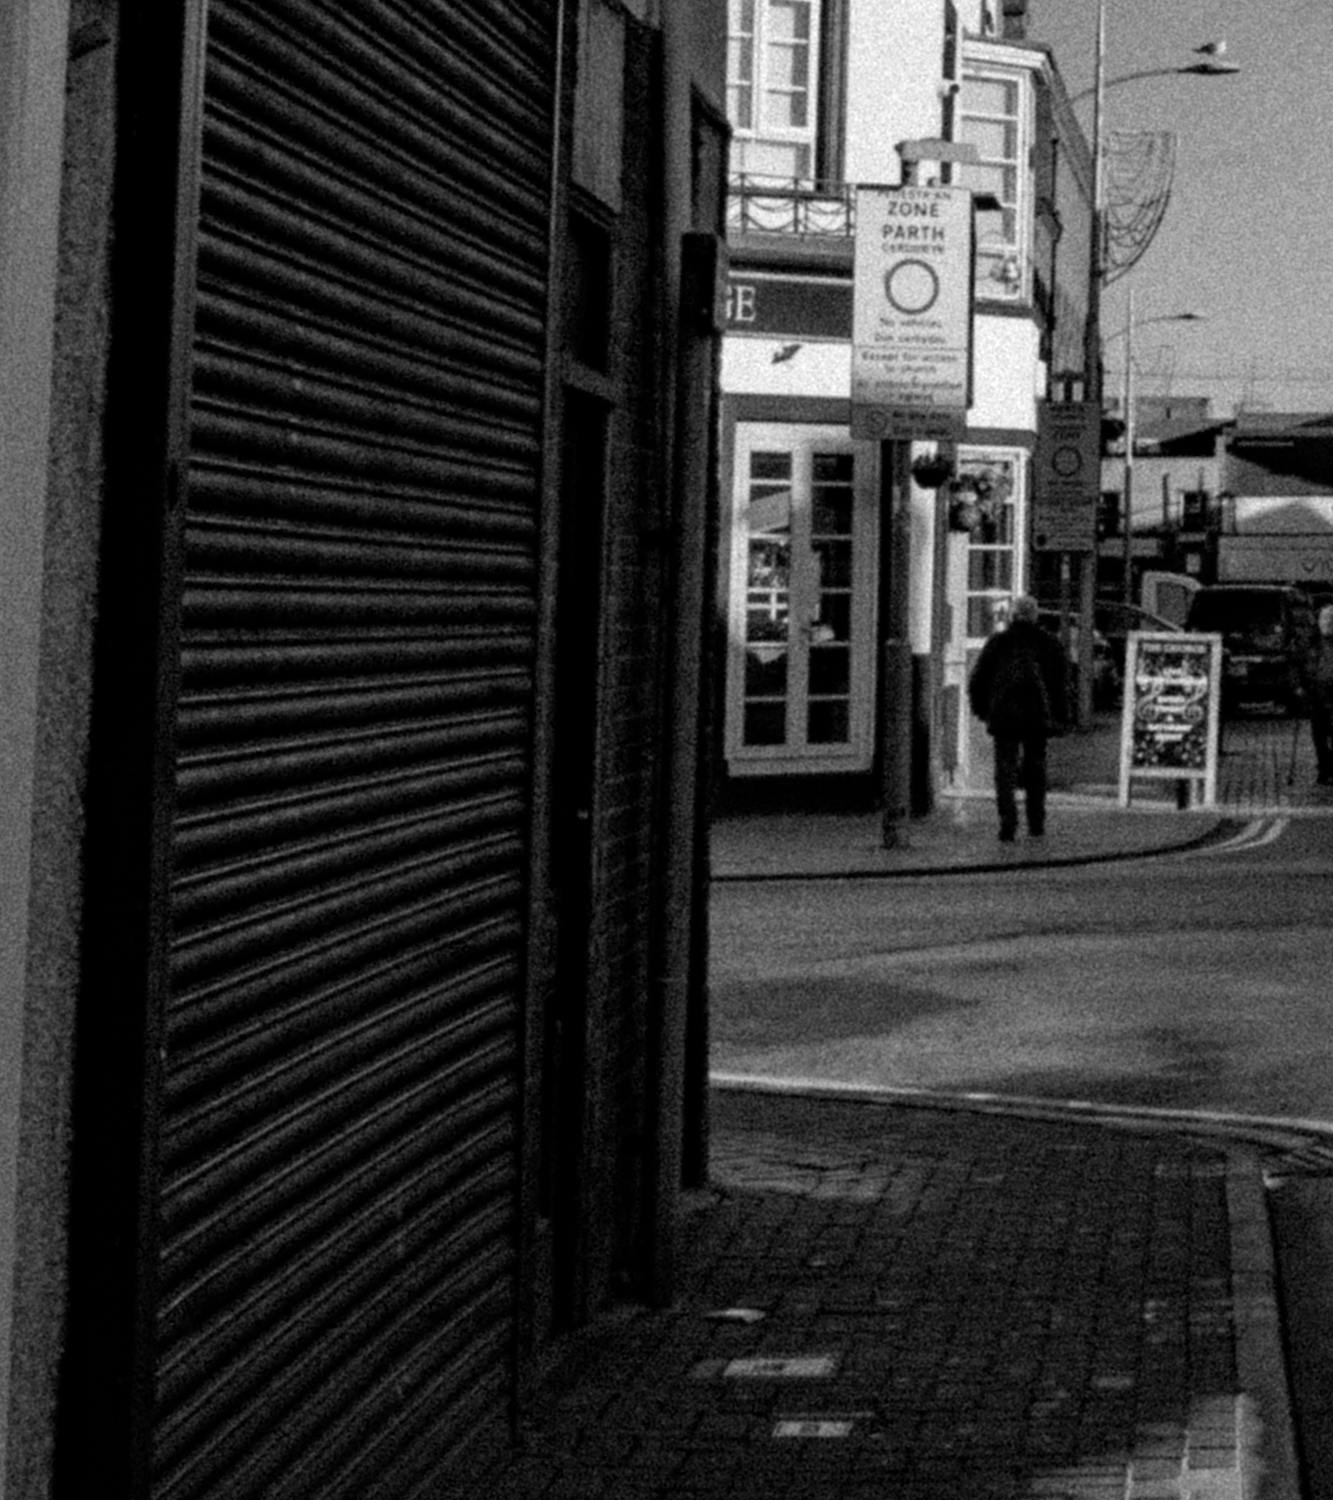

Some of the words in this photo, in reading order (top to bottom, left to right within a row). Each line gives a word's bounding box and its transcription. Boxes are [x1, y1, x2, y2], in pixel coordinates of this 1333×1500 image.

[887, 200, 940, 218] ZONE
[882, 223, 945, 241] PARTH
[726, 285, 756, 322] E
